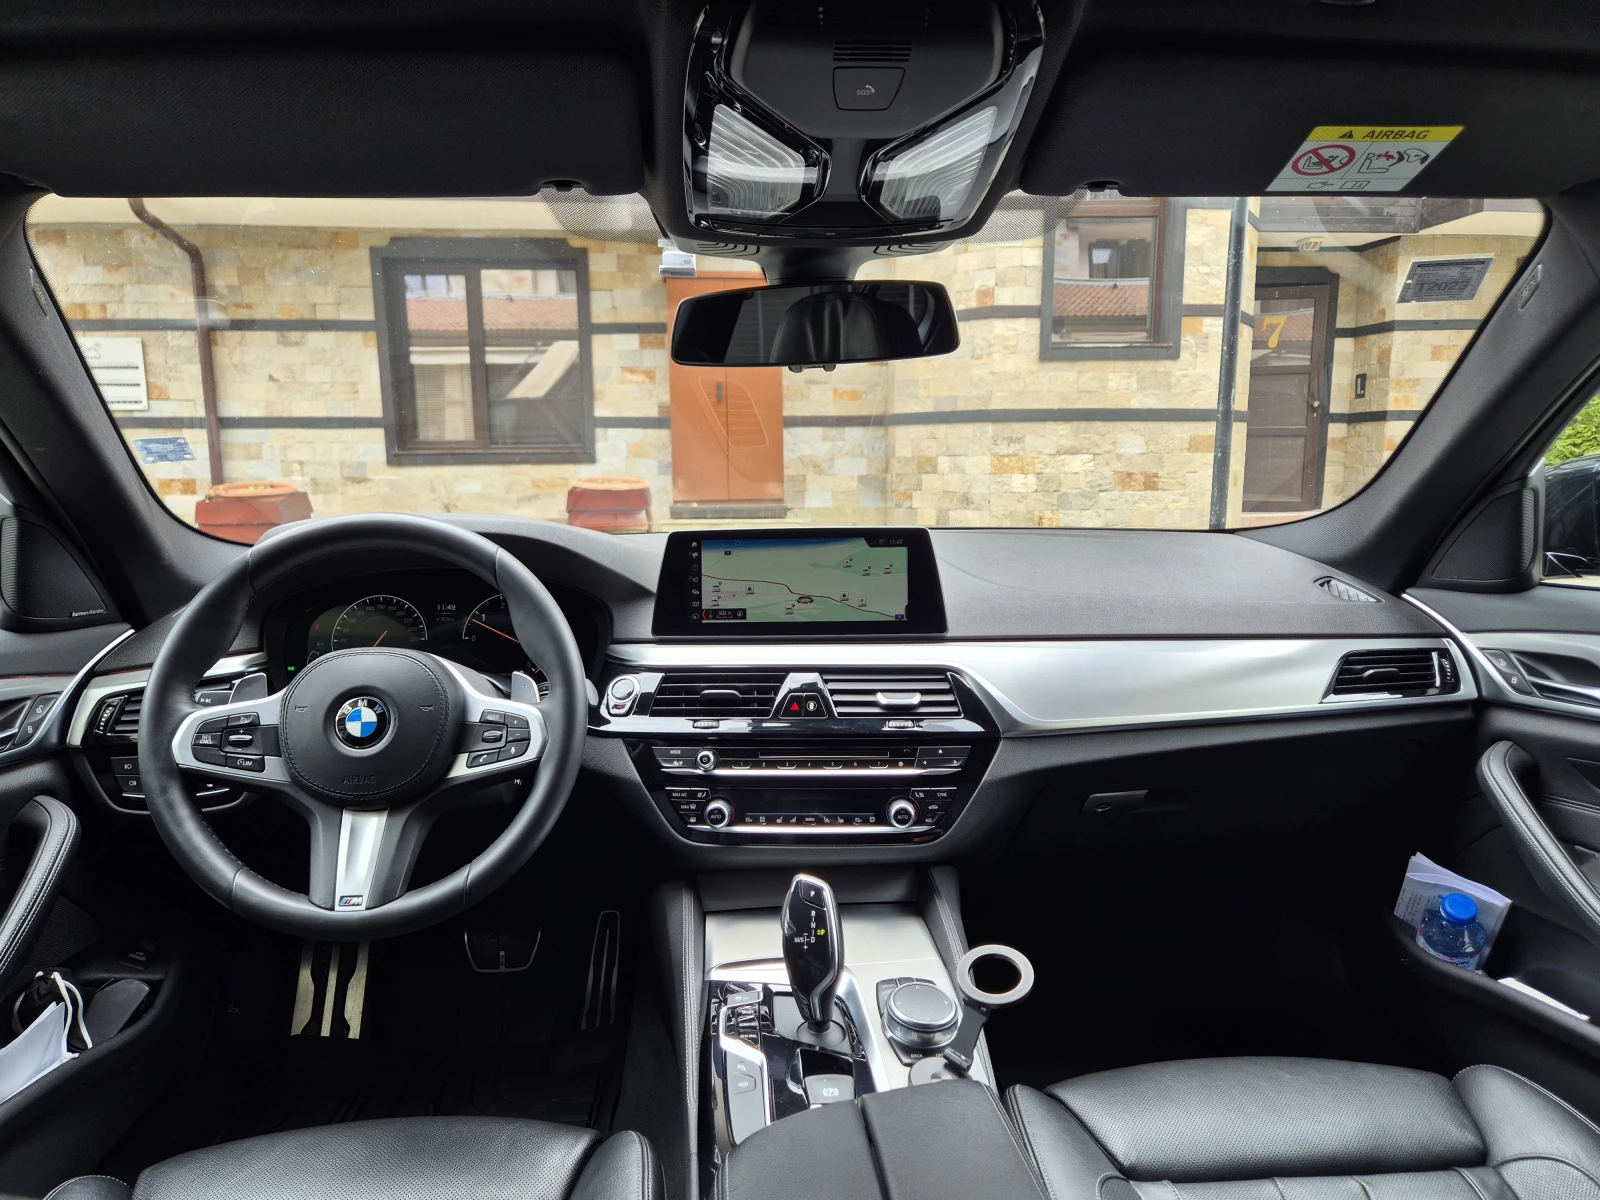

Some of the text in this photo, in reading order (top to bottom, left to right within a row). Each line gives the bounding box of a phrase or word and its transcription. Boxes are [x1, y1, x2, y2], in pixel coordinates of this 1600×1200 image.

[1362, 130, 1430, 139] AIRBAG
[1263, 316, 1287, 349] 7
[437, 603, 456, 611] 11:49
[342, 699, 384, 714] BMW
[342, 775, 376, 785] AIRBAG
